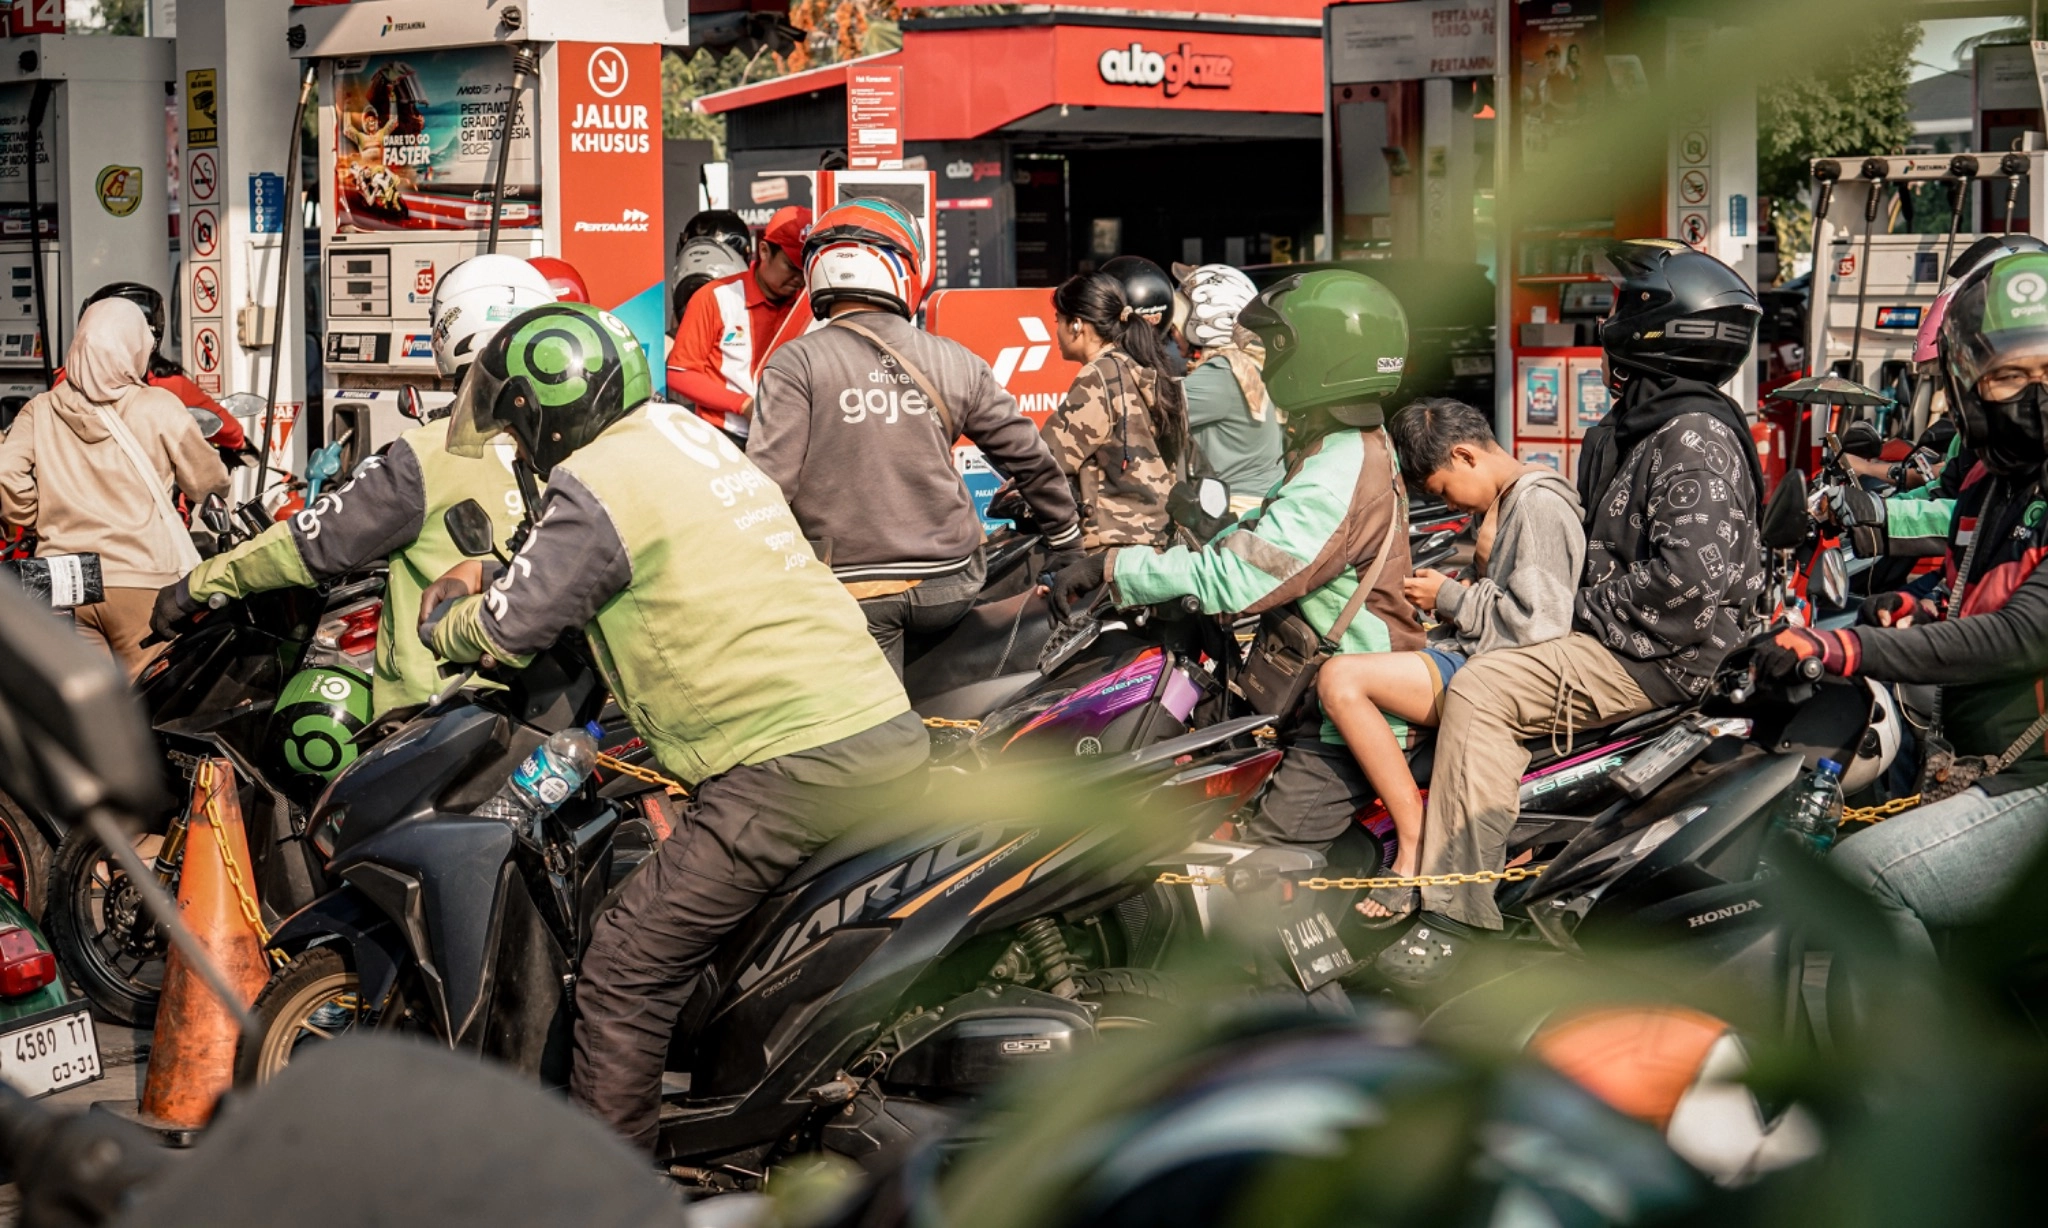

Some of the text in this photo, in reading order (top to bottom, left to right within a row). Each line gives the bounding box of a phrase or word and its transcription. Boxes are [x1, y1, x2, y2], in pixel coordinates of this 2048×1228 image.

[14, 0, 65, 27] 14
[395, 22, 426, 32] PERTAMINA
[1433, 23, 1471, 38] TURBO
[1098, 43, 1233, 97] autoglaze
[461, 101, 523, 115] PERTAMIA
[571, 104, 649, 129] JALUR
[461, 114, 525, 128] GRAND PIX
[383, 133, 430, 146] DARE TO GO
[461, 127, 531, 141] OF INDOESIA
[571, 133, 649, 153] KHUSUS
[382, 146, 430, 166] FASTER
[462, 143, 490, 155] 2025
[10, 154, 50, 165] INDOESIA
[574, 221, 649, 232] PERTAMAX
[1102, 674, 1154, 695] GEAR
[1532, 755, 1624, 796] GEAR
[945, 828, 1040, 897] LIQUID COOLED
[738, 827, 1005, 991] VARIO
[1688, 899, 1763, 928] HONDA
[1282, 928, 1299, 956] B
[67, 1017, 87, 1045] TT
